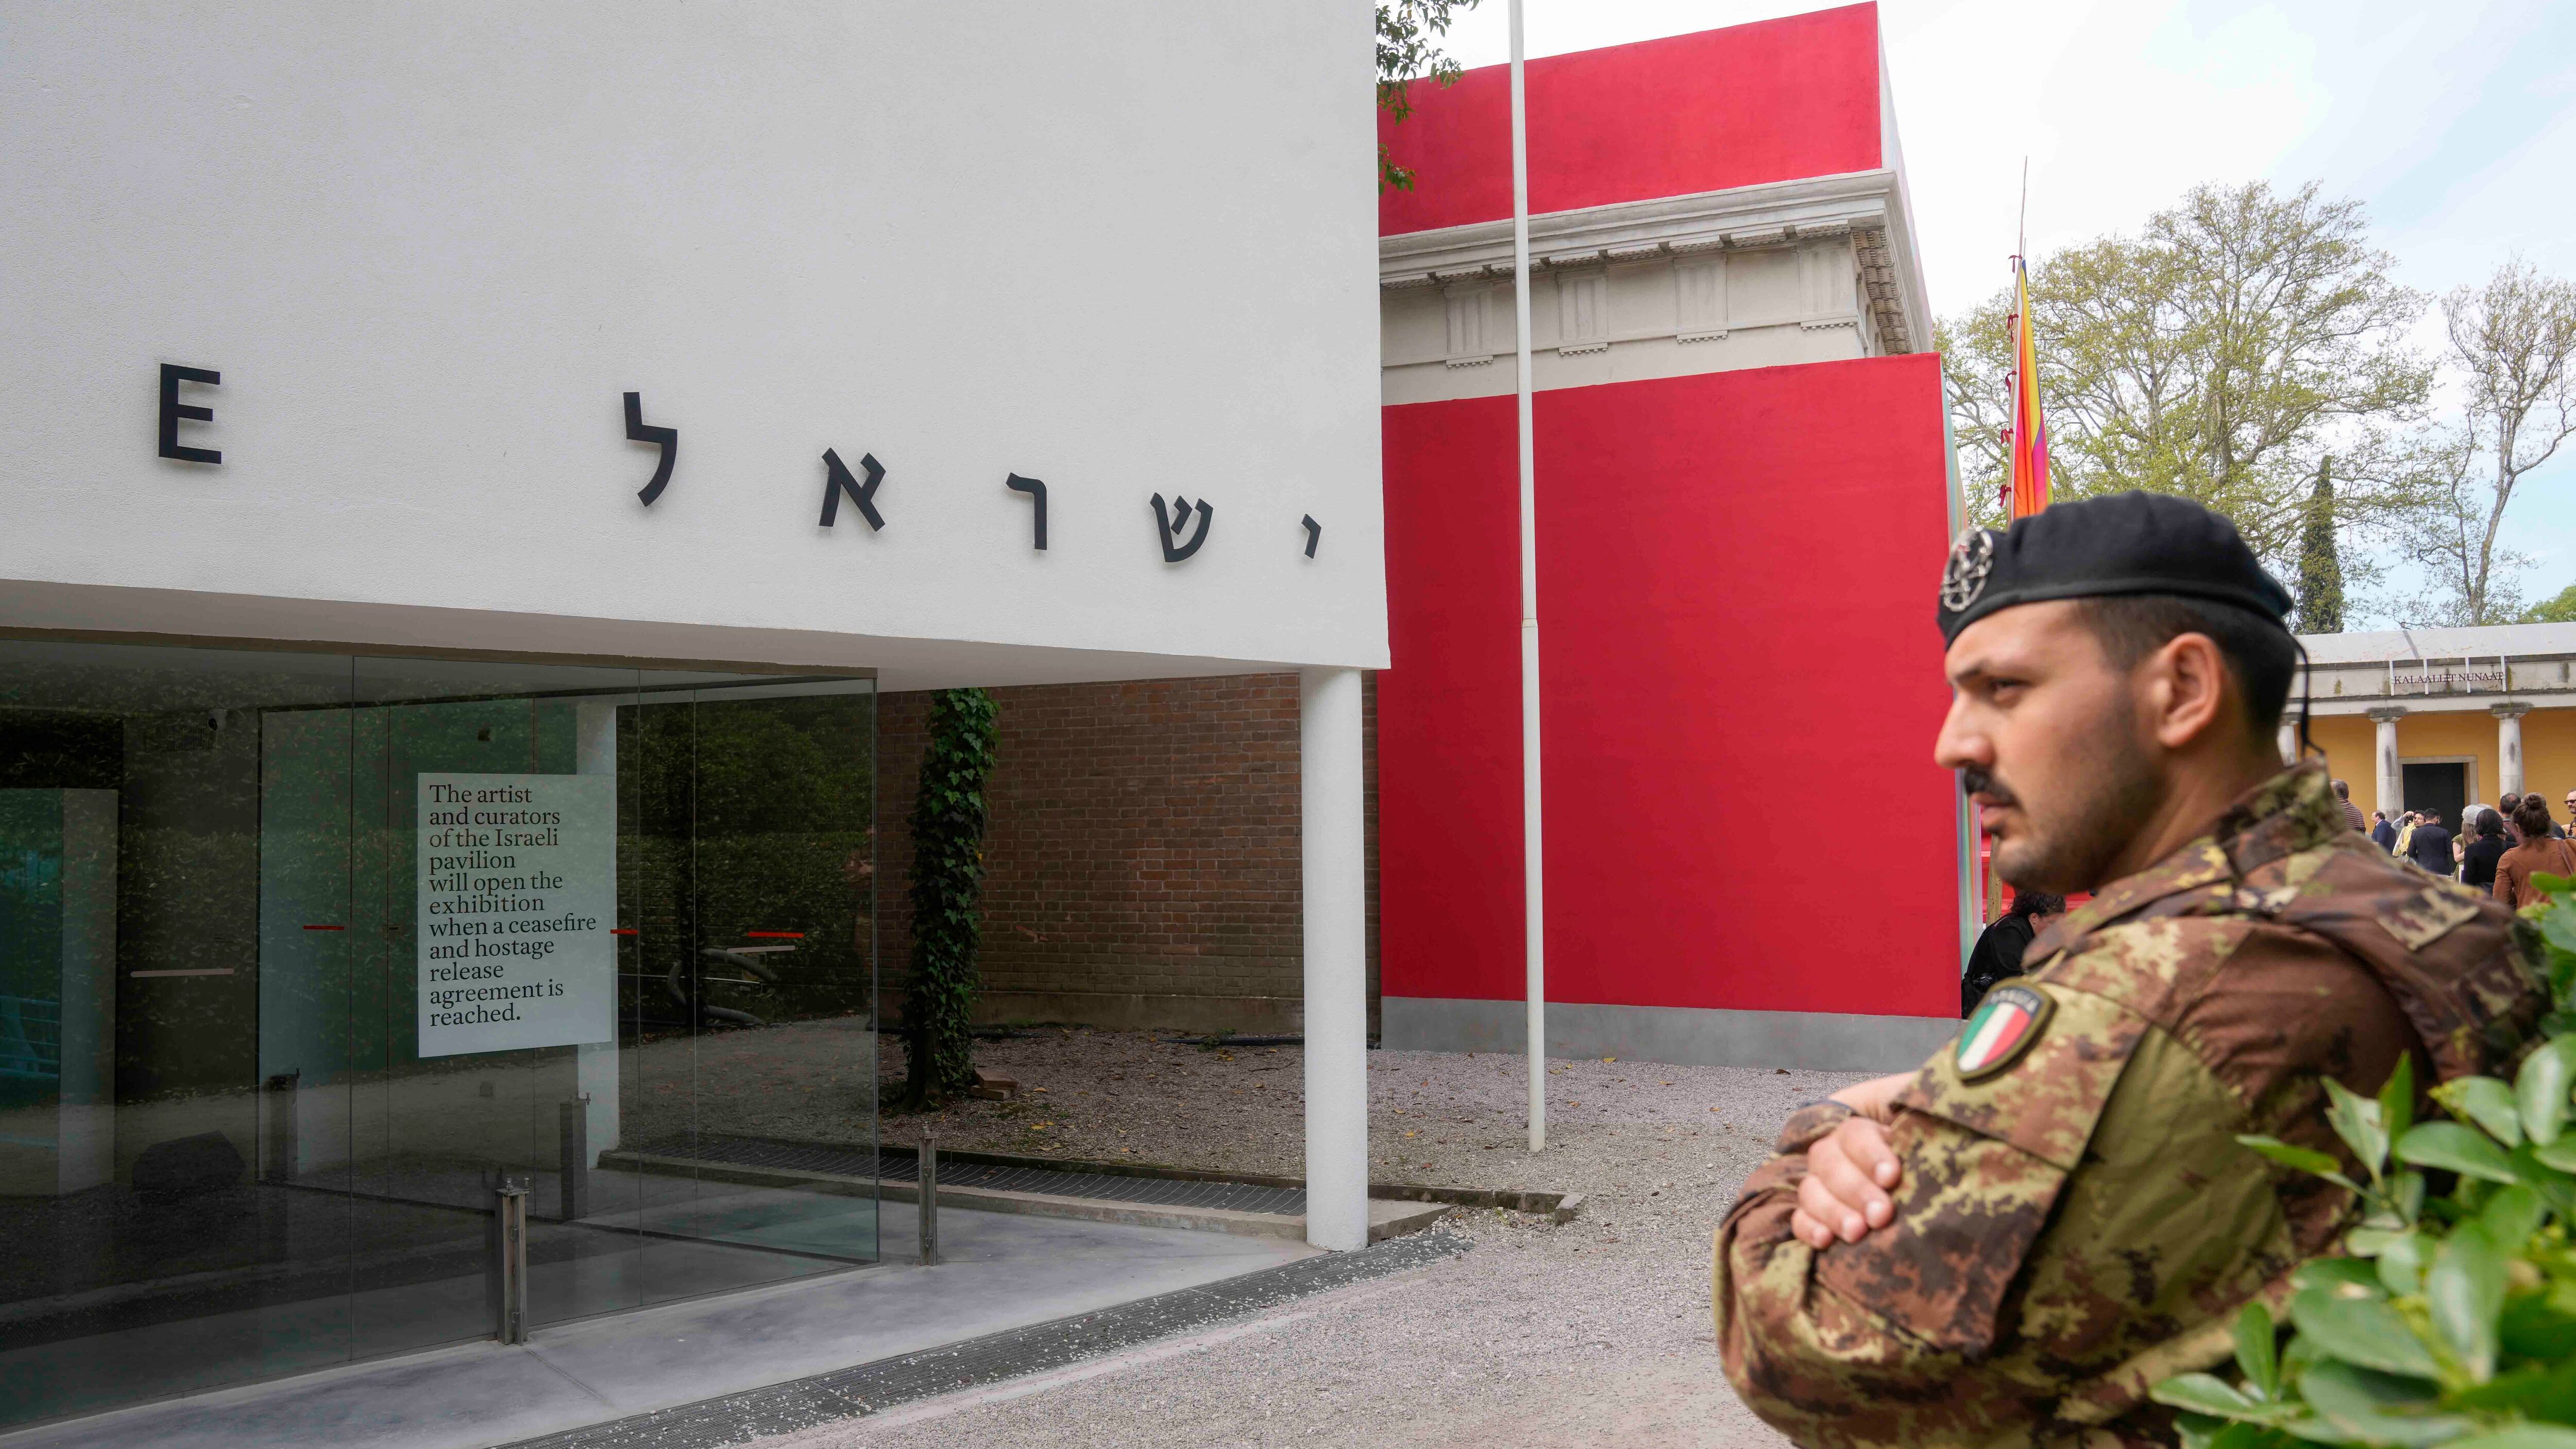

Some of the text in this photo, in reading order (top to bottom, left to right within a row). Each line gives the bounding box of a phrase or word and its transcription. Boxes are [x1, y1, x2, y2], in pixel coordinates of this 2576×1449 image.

[158, 363, 222, 465] E
[623, 391, 1322, 563] ישראל
[2394, 672, 2503, 684] KALAALLIT NUNAAT
[429, 784, 533, 803] The artist
[429, 806, 560, 825] and curators
[429, 827, 560, 848] of the Israeli
[429, 850, 517, 876] pavilion
[429, 870, 563, 896] will open the
[429, 894, 546, 915] exhibition
[429, 912, 597, 937] when a ceasefire
[430, 937, 554, 960] and hostage
[430, 961, 504, 982] release
[430, 978, 564, 1010] agreement is
[430, 1002, 521, 1027] reached.
